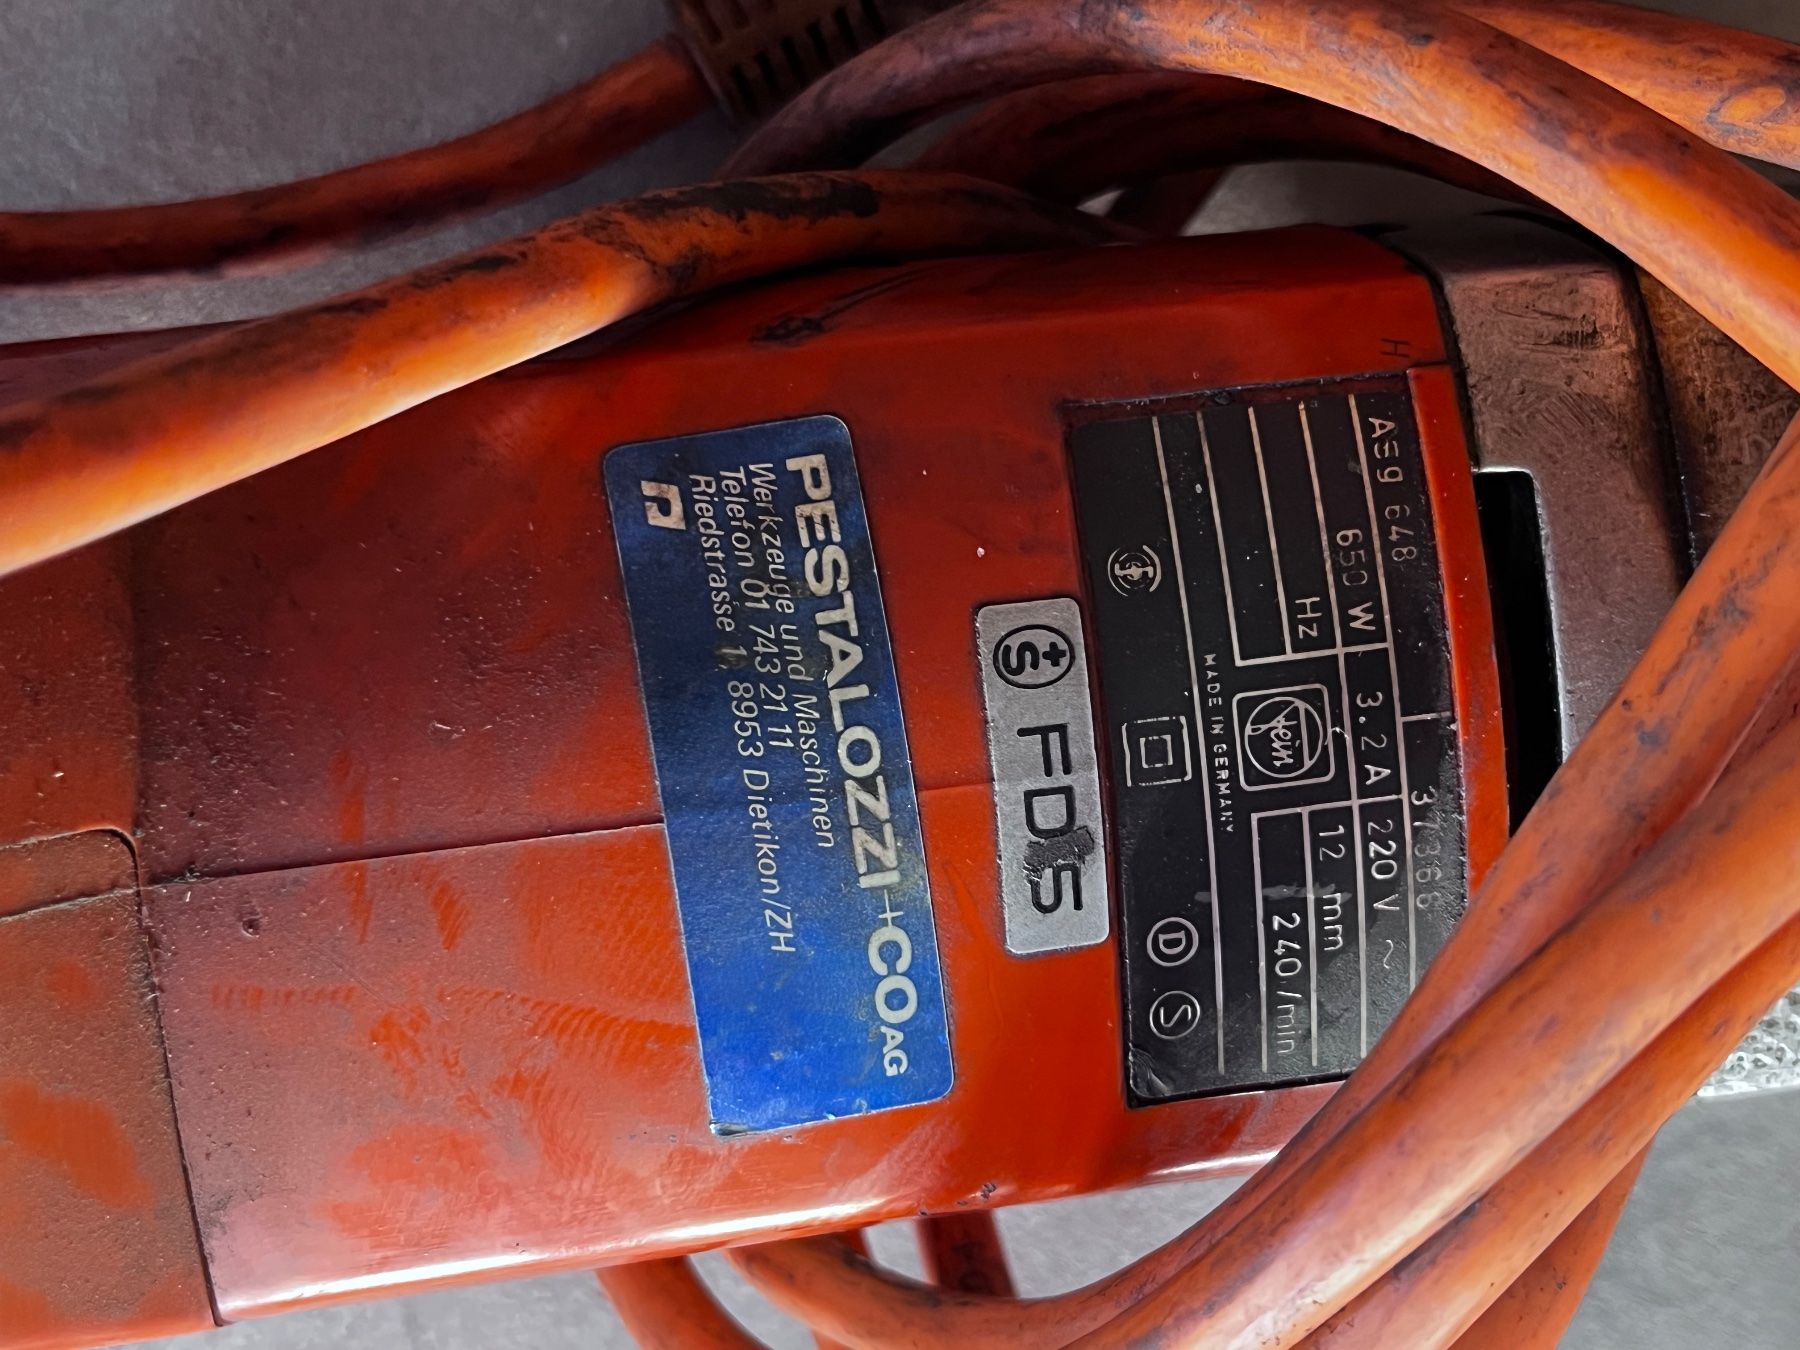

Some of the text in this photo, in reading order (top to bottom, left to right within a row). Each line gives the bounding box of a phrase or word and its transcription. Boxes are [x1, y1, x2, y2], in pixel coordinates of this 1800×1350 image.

[688, 474, 735, 632] Riedstrasse
[1336, 528, 1376, 631] 650 W
[1384, 504, 1417, 563] 648
[719, 466, 795, 750] Telefon 01 743 21 11
[748, 463, 835, 847] Werkzeuge und Maschinen
[1295, 597, 1321, 640] Hz
[727, 681, 765, 758] 8953
[1203, 653, 1234, 832] MADE IN GERMANY
[1356, 691, 1392, 786] 3.2 A
[741, 768, 796, 952] Dietikon/ZH
[1318, 824, 1345, 952] 12 mm
[1367, 820, 1398, 881] 220
[1373, 894, 1400, 911] V
